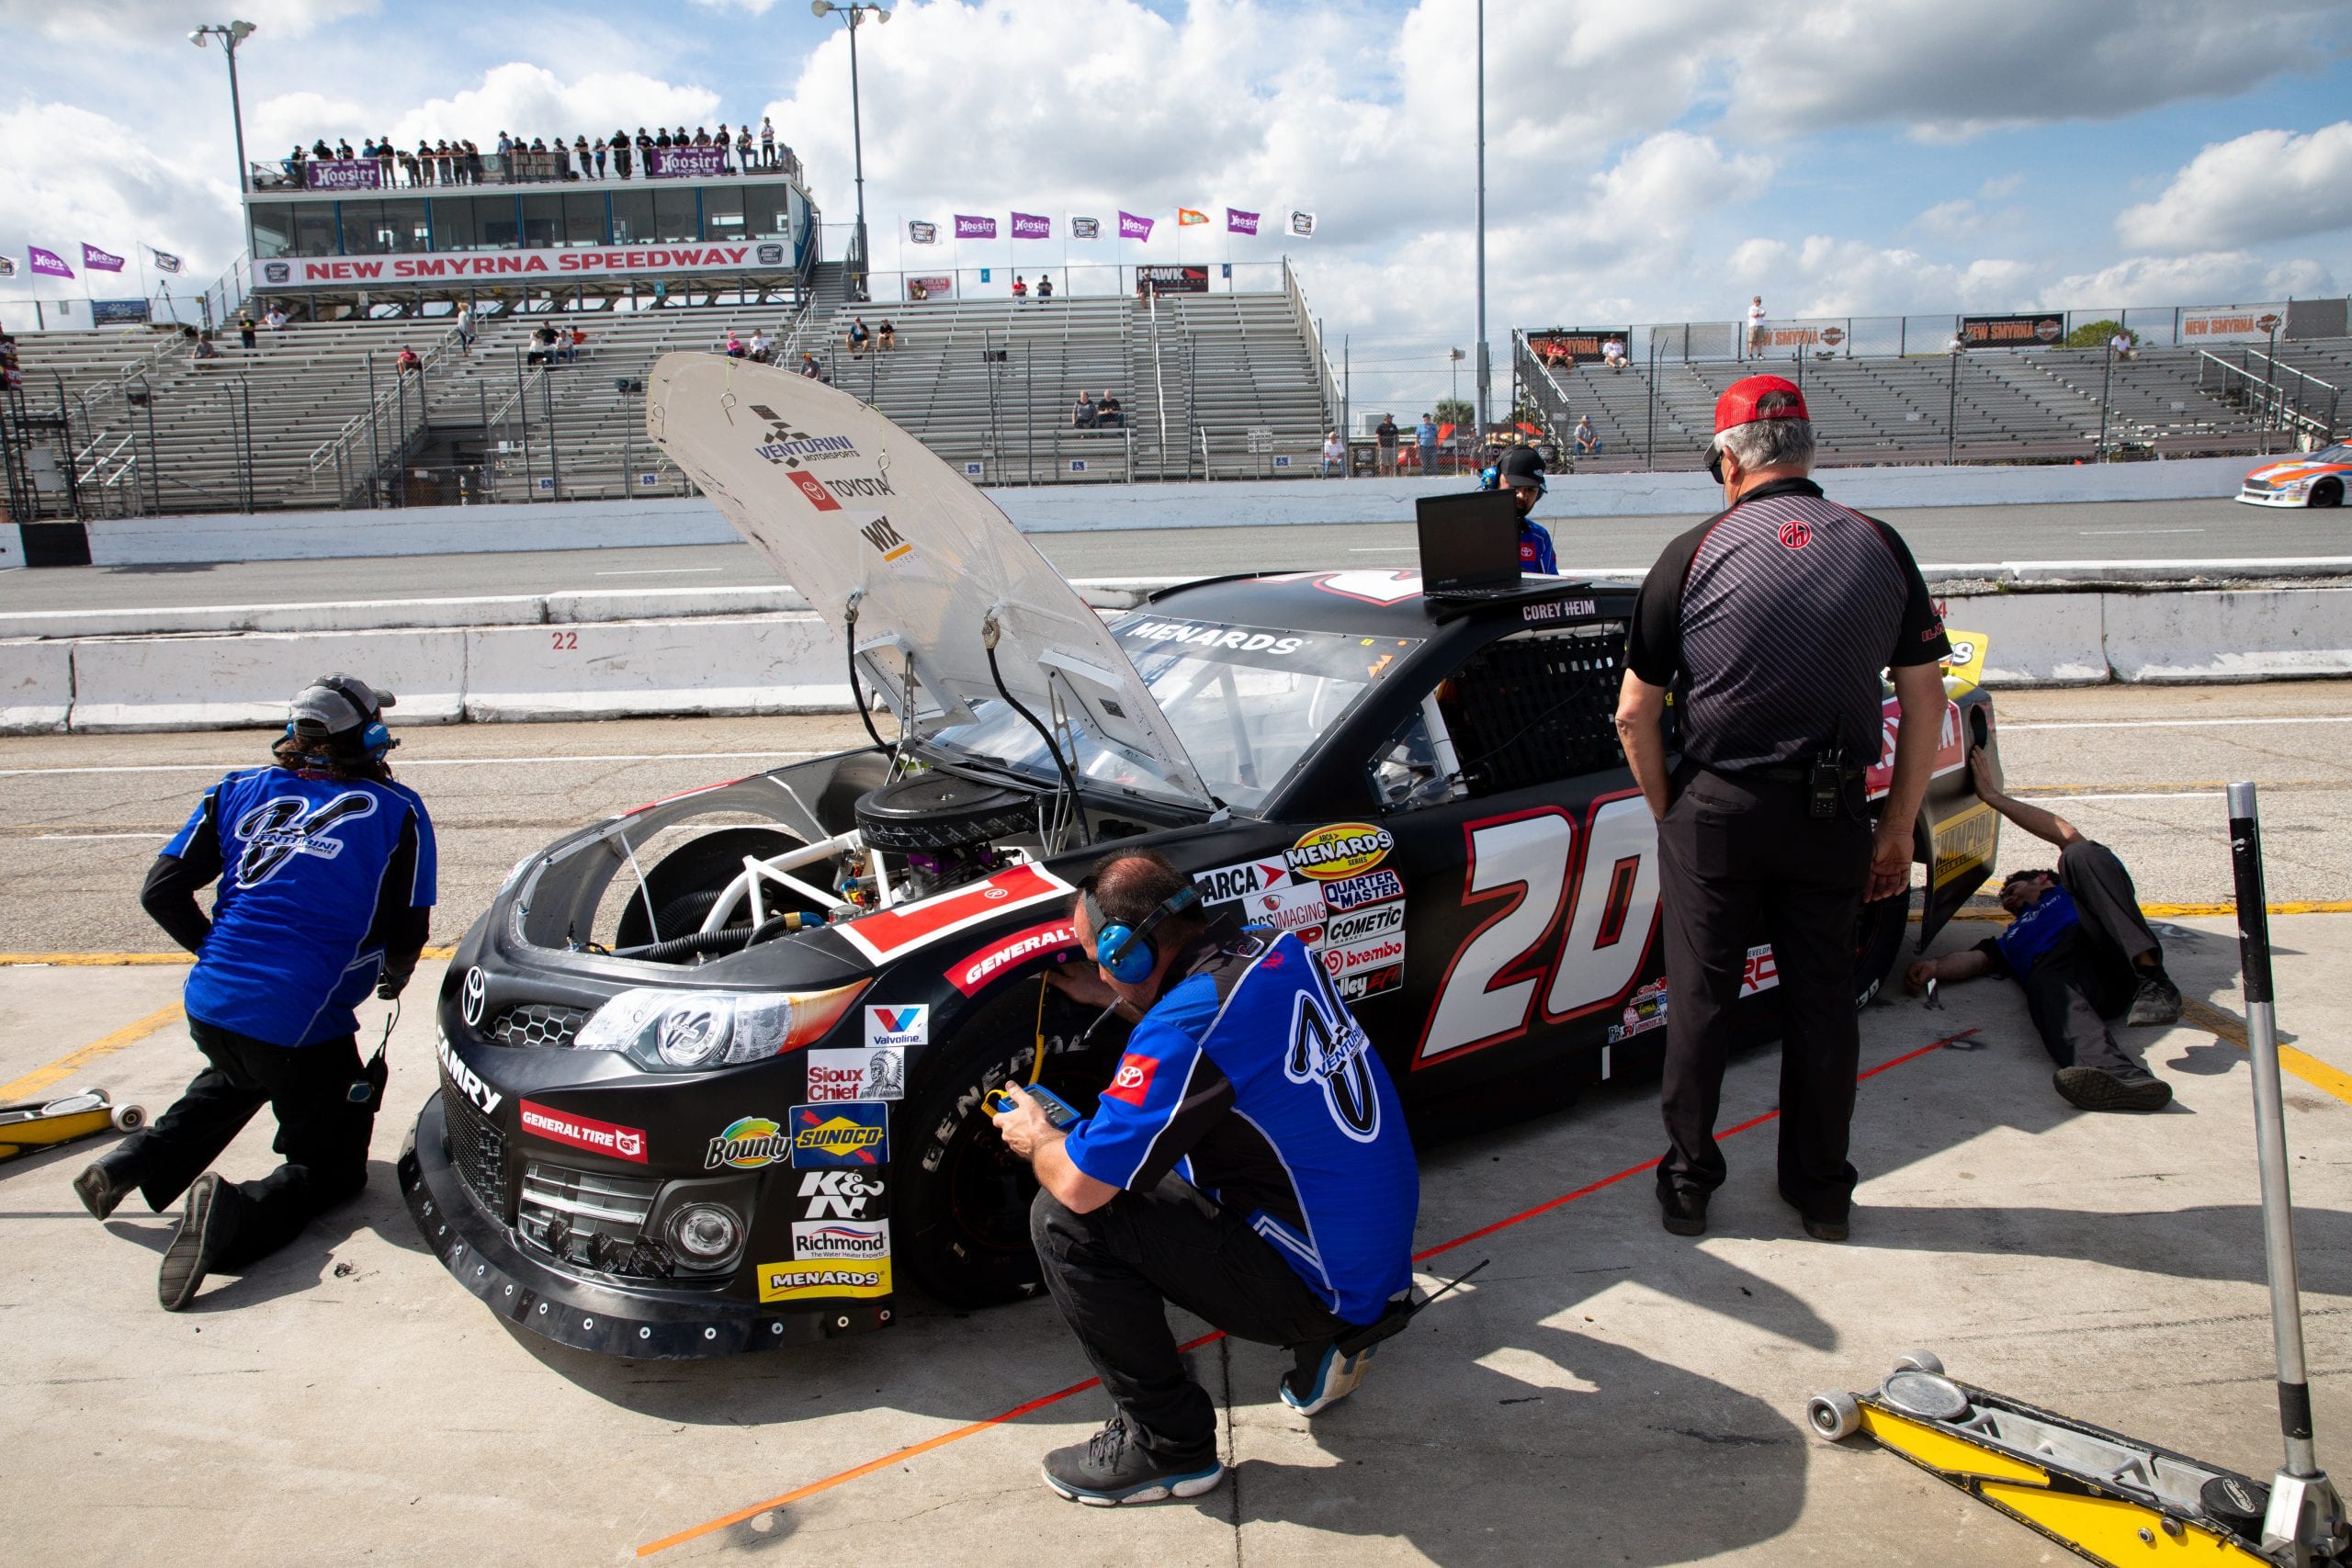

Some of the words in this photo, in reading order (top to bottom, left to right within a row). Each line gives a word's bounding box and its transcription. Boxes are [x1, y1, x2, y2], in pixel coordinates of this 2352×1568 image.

[658, 153, 719, 174] Hoosier
[314, 165, 376, 186] Hoosier
[959, 220, 995, 231] Hoosier
[305, 261, 383, 280] NEW
[393, 254, 548, 276] SMYRNA
[559, 247, 749, 271] SPEEDWAY
[1990, 322, 2034, 340] SMYRNA
[2185, 320, 2209, 335] NEW
[2211, 318, 2254, 334] SMYRNA
[1562, 339, 1599, 355] MYRNA
[754, 435, 854, 459] VENTURINI
[803, 449, 861, 462] MOTORSPORTS
[824, 478, 896, 498] TOYOTA
[860, 515, 905, 553] WIX
[1522, 602, 1562, 621] COREY
[1564, 600, 1596, 616] HEIM
[552, 632, 578, 649] 22
[1126, 622, 1305, 655] MENARDS
[1319, 833, 1333, 842] ARCA
[1286, 831, 1393, 868] MENARDS
[1348, 856, 1368, 866] SERIES
[1203, 866, 1260, 903] ARCA
[1325, 871, 1396, 902] QUARTER
[1341, 880, 1401, 908] MASTER
[1331, 908, 1402, 941] COMETIC
[1411, 788, 1662, 1072] 20
[966, 926, 1069, 985] GENERAL
[1346, 942, 1402, 968] brembo
[1747, 947, 1770, 958] EVELOP
[873, 1035, 920, 1045] Valvoline
[808, 1066, 865, 1084] Sioux
[808, 1083, 858, 1101] Chief
[522, 1111, 581, 1139] GENERAL
[582, 1127, 616, 1147] TIRE
[798, 1128, 881, 1147] SUNOCO
[705, 1134, 792, 1168] Bounty
[796, 1231, 885, 1252] Richmond
[862, 1250, 885, 1259] Experts
[771, 1270, 880, 1290] MENARDS
